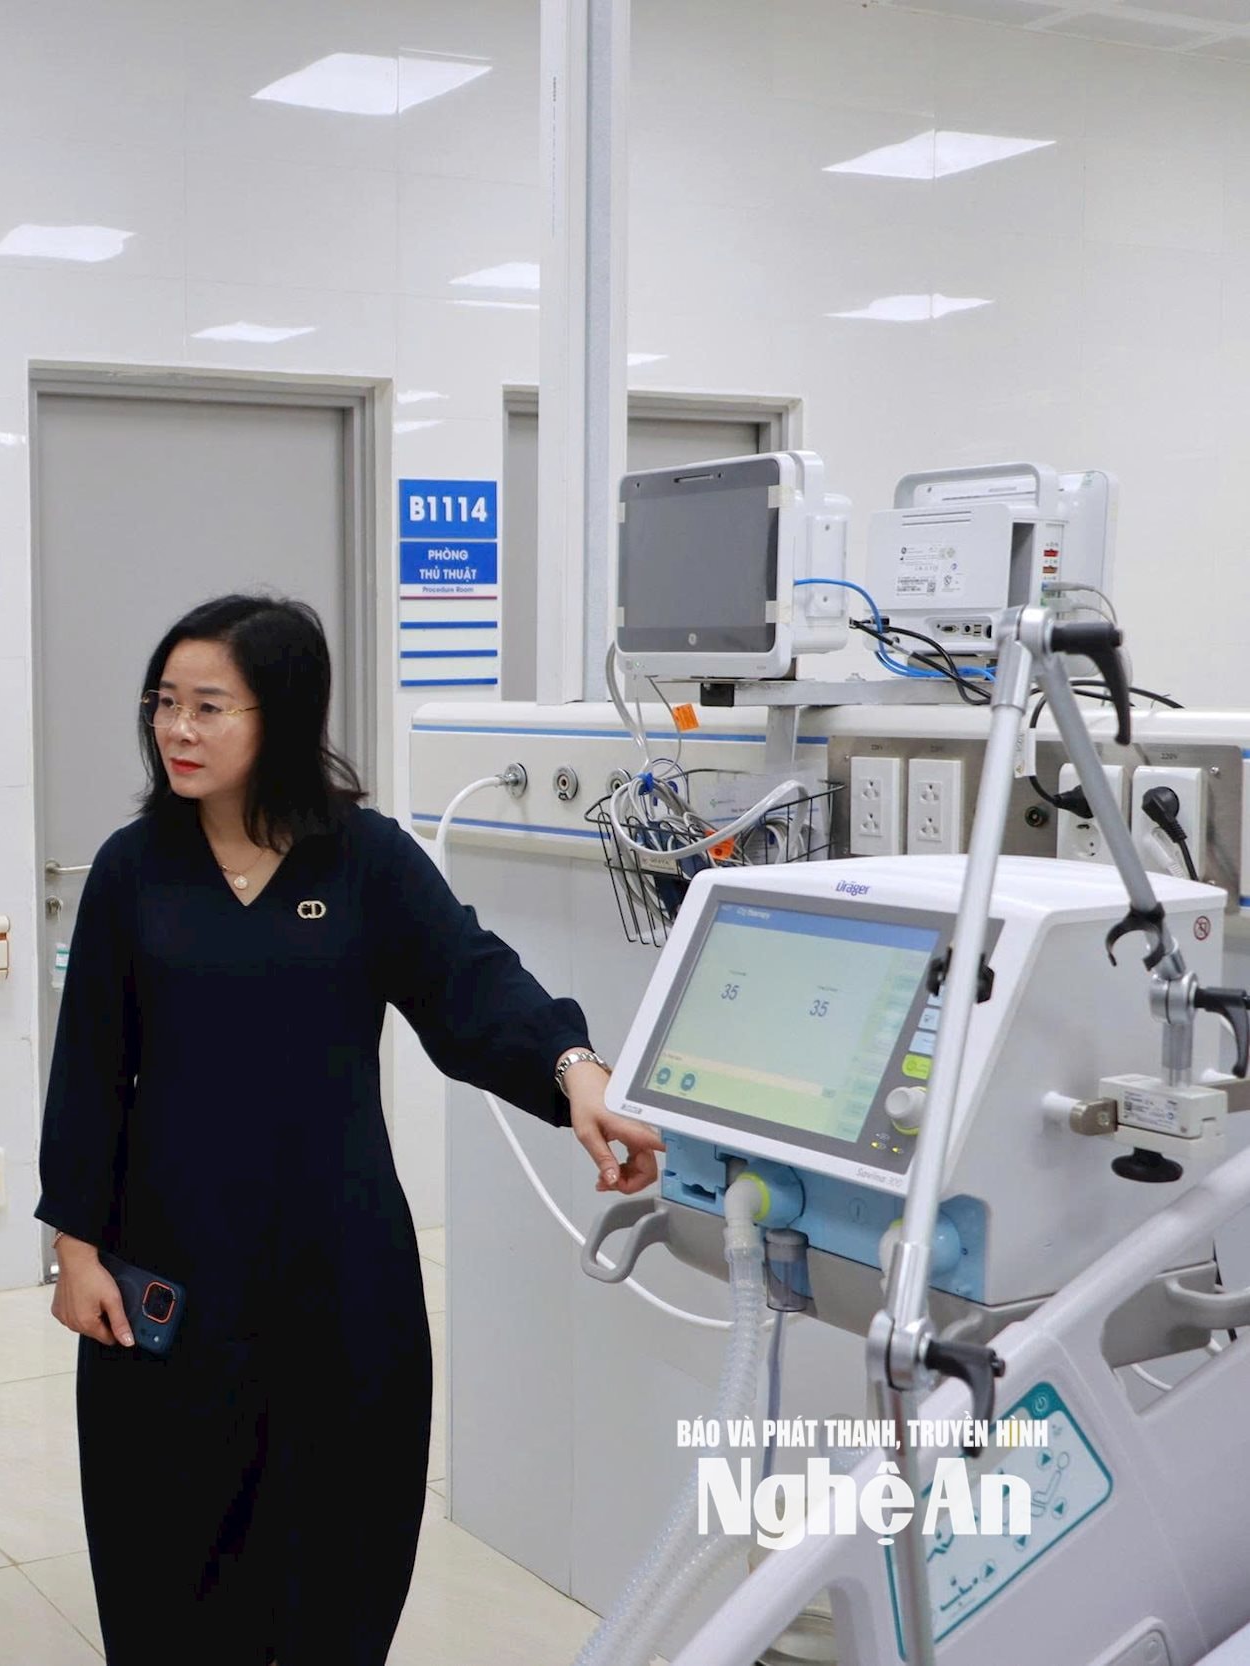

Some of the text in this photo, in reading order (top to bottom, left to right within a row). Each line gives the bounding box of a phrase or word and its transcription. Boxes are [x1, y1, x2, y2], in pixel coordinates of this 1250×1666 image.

[410, 496, 487, 522] B1114
[428, 547, 469, 560] PHÒNG
[419, 565, 477, 582] THỦ THUẬT
[835, 879, 871, 896] Dräger
[721, 983, 740, 1001] 35
[809, 999, 830, 1017] 35
